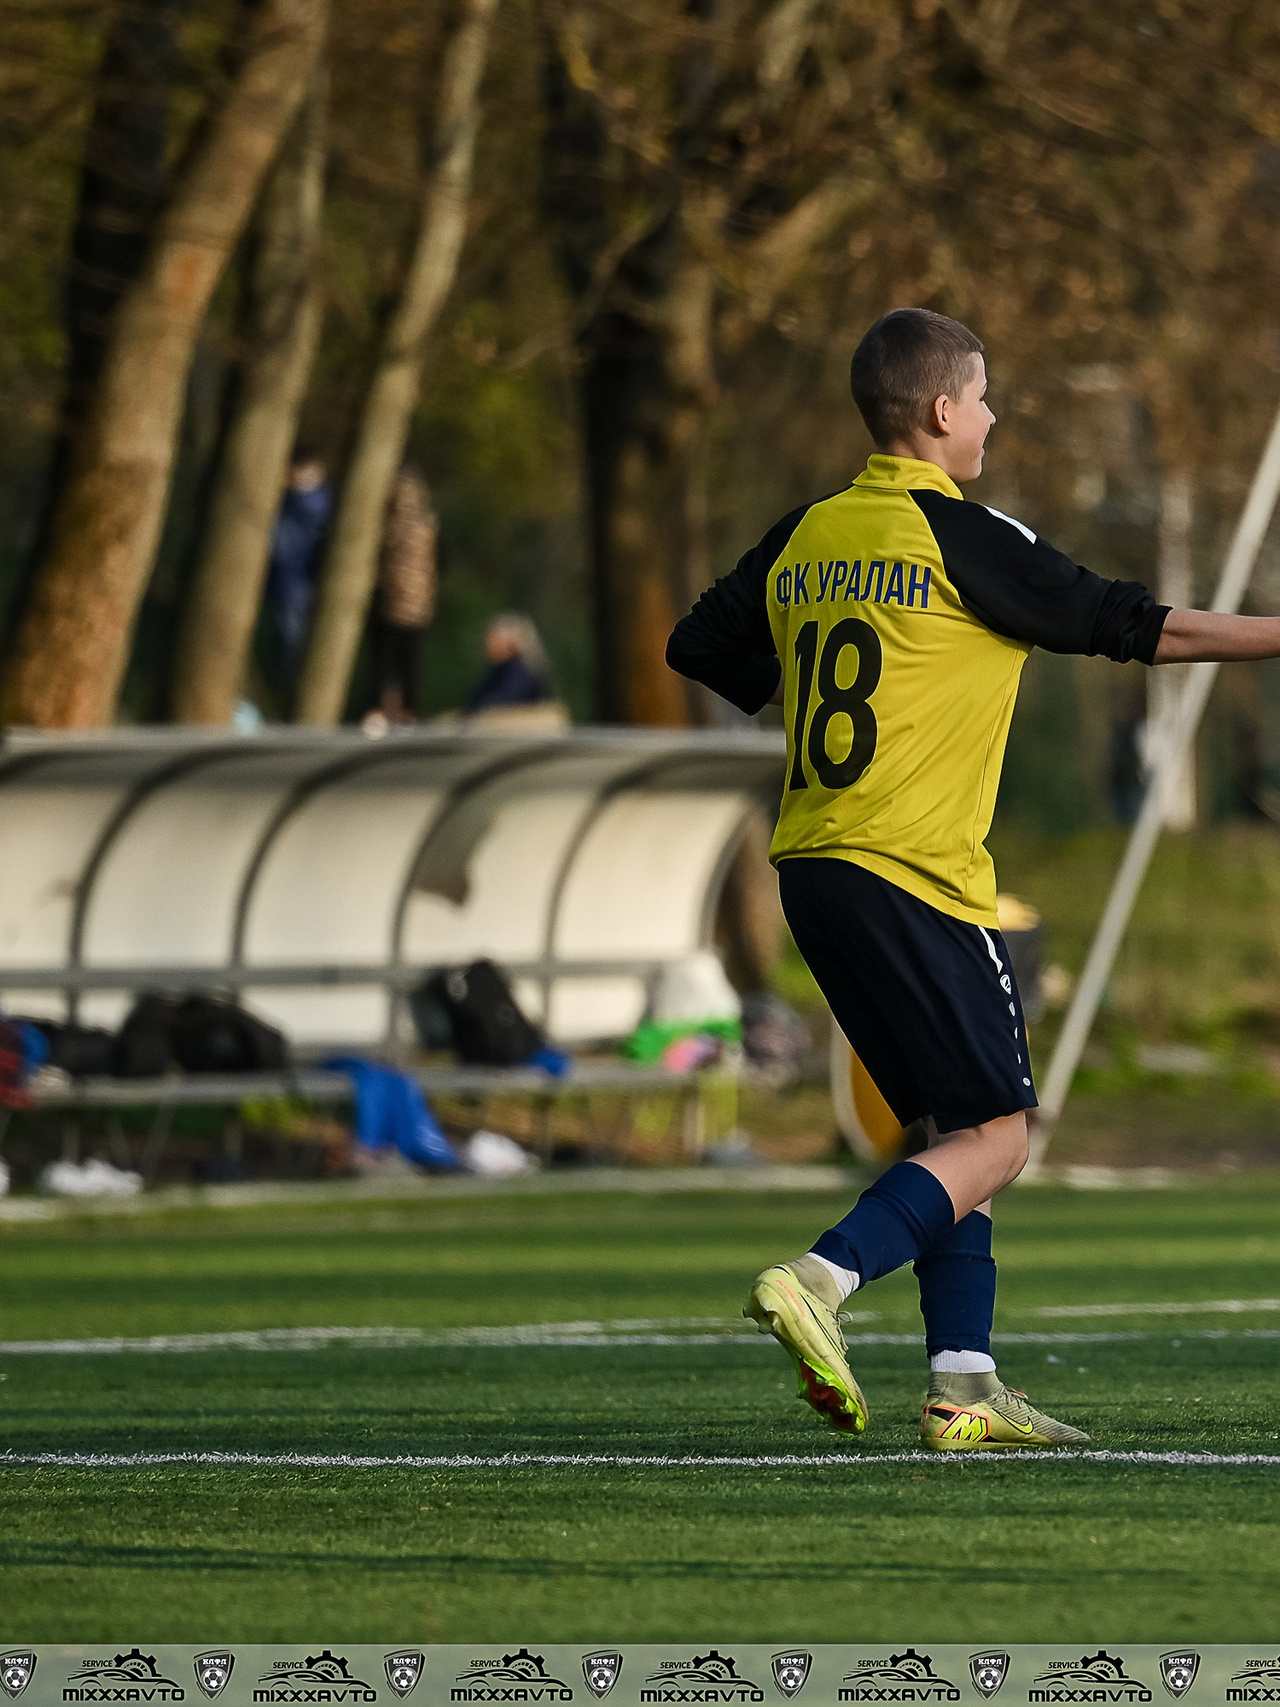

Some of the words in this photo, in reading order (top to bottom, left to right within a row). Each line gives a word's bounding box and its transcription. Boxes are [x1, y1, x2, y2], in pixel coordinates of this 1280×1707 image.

[776, 561, 811, 608] ФК
[816, 560, 931, 608] УРАЛАН
[789, 617, 882, 791] 18
